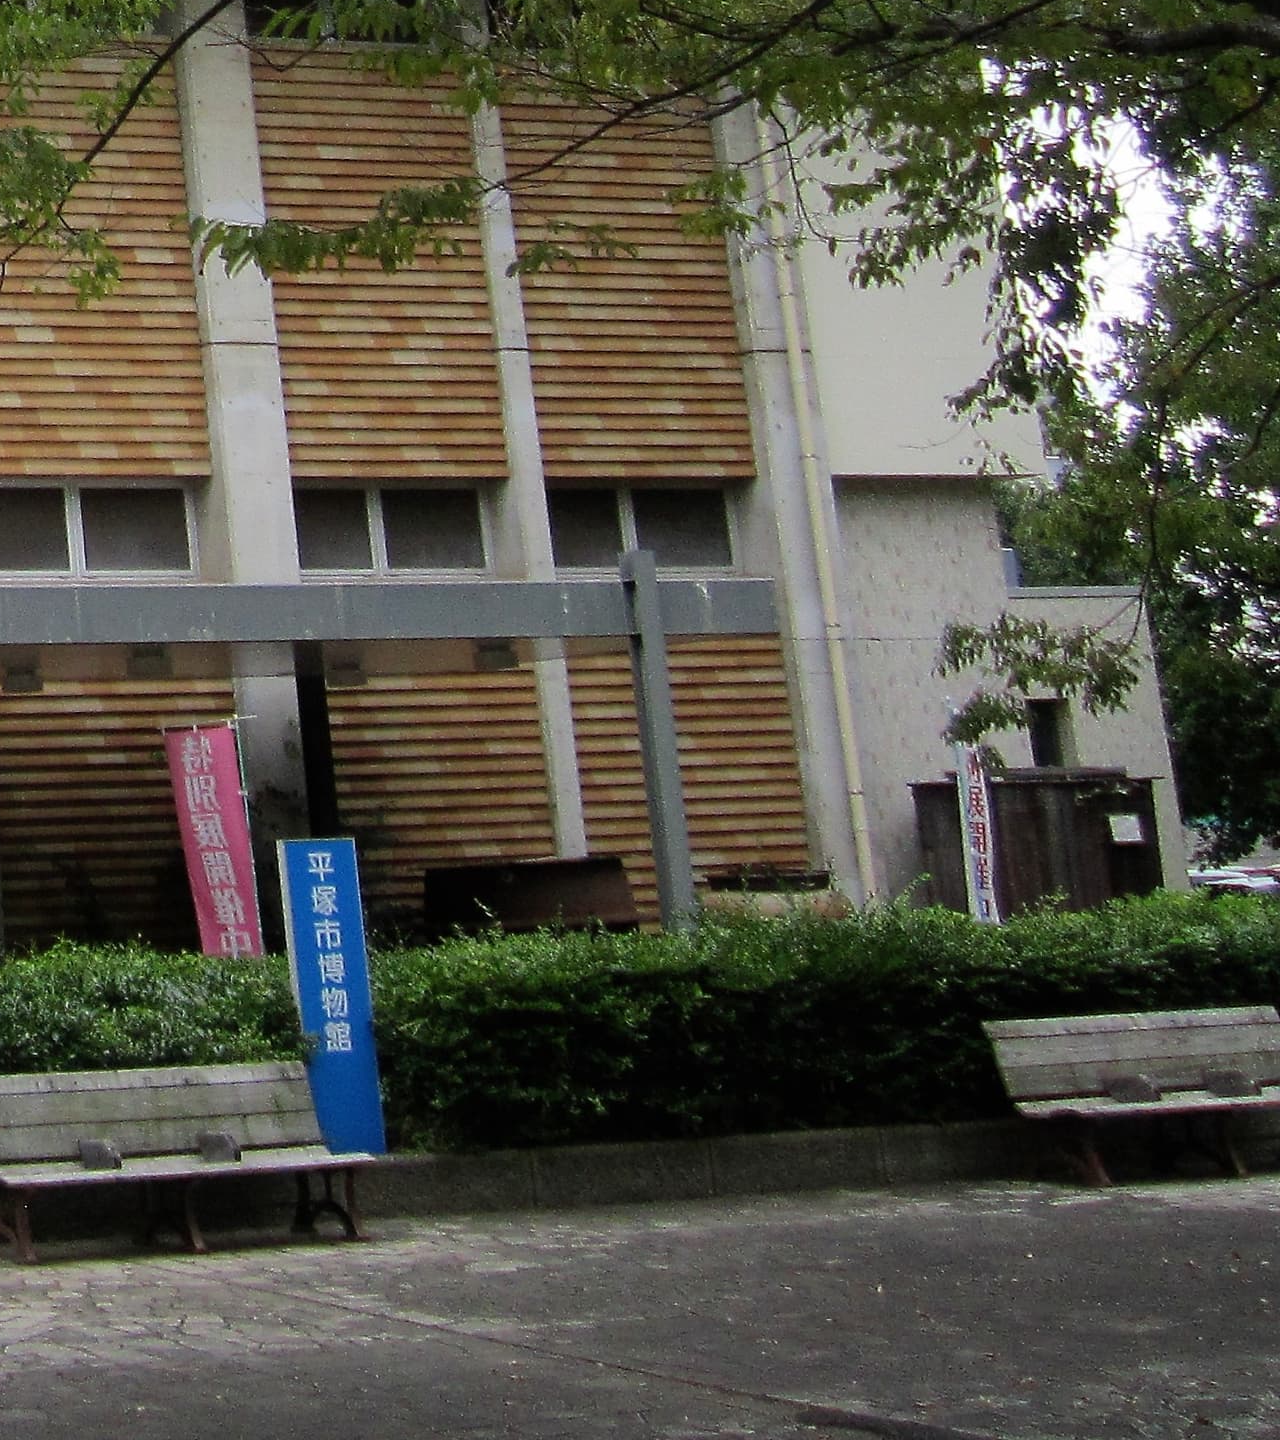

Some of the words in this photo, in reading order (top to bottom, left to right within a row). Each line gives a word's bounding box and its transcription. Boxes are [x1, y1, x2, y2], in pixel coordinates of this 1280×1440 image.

[307, 852, 352, 1052] 平塚市博物館
